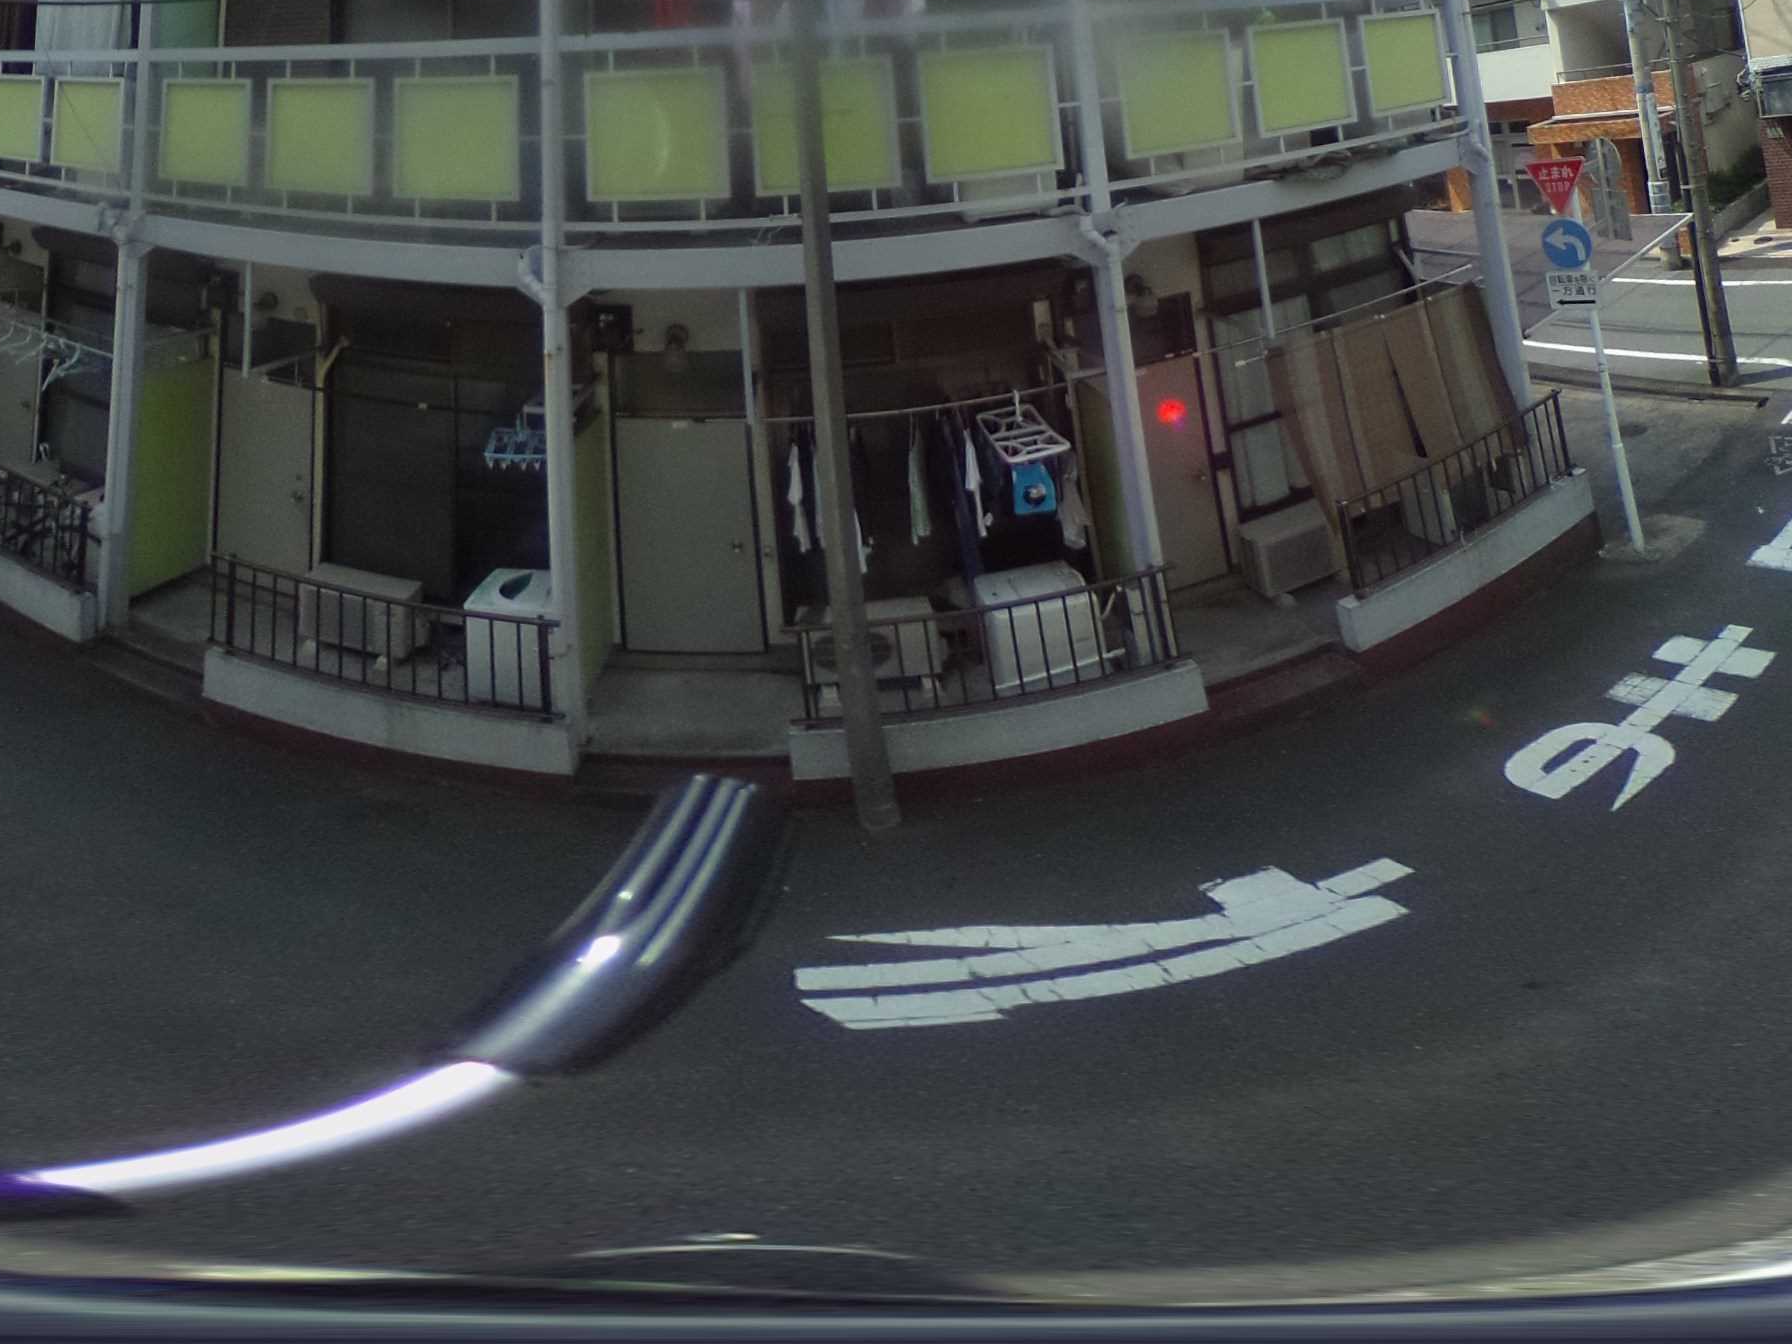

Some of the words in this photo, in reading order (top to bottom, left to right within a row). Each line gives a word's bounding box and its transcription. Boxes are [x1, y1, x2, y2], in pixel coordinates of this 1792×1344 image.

[1538, 166, 1574, 180] 止まれ
[1545, 181, 1571, 193] STOP
[1551, 286, 1597, 296] 一方通行
